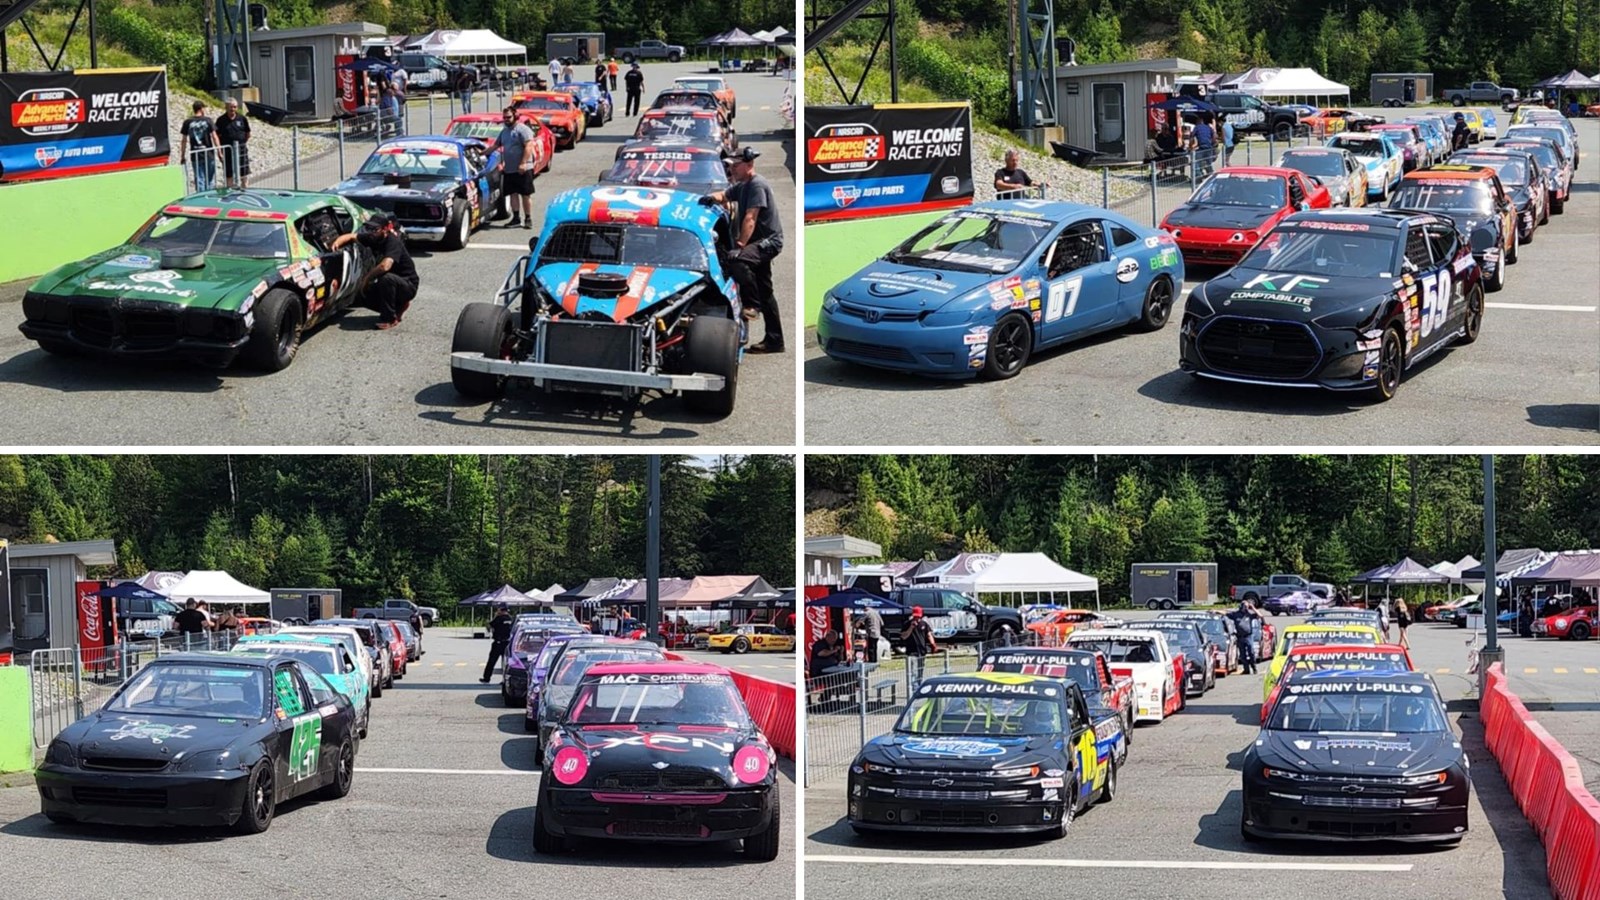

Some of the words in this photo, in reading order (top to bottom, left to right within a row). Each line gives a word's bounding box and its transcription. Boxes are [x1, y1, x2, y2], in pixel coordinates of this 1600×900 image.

[91, 90, 161, 108] WELCOME
[24, 103, 65, 115] Advance
[88, 108, 122, 123] RACE
[123, 105, 159, 120] FANS!
[17, 114, 40, 125] Auto
[40, 112, 65, 122] Parts
[892, 127, 965, 145] WELCOME
[63, 148, 81, 157] AUTO
[82, 146, 104, 156] PARTS
[820, 140, 864, 152] Advance
[888, 145, 924, 161] RACE
[925, 143, 962, 158] FANS!
[813, 150, 837, 161] Auto
[838, 150, 864, 159] Parts
[863, 187, 880, 197] AUTO
[882, 185, 904, 196] PARTS
[1243, 273, 1329, 291] KF
[1046, 276, 1082, 323] 07
[1230, 292, 1313, 305] COMPTABILITÉ
[1421, 269, 1451, 338] 59
[880, 576, 892, 592] 3
[752, 636, 764, 644] 10
[998, 655, 1034, 664] KENNY
[1037, 656, 1077, 665] U-PULL
[1305, 653, 1342, 661] KENNY
[600, 674, 639, 684] MAC
[650, 674, 729, 683] Construction
[935, 684, 984, 693] KENNY
[985, 684, 1038, 694] U-PULL
[1302, 683, 1353, 694] KENNY
[1356, 683, 1412, 693] U-PULL
[603, 734, 735, 753] XPN
[1078, 729, 1098, 784] 16
[562, 758, 579, 773] 40
[743, 757, 760, 771] 40
